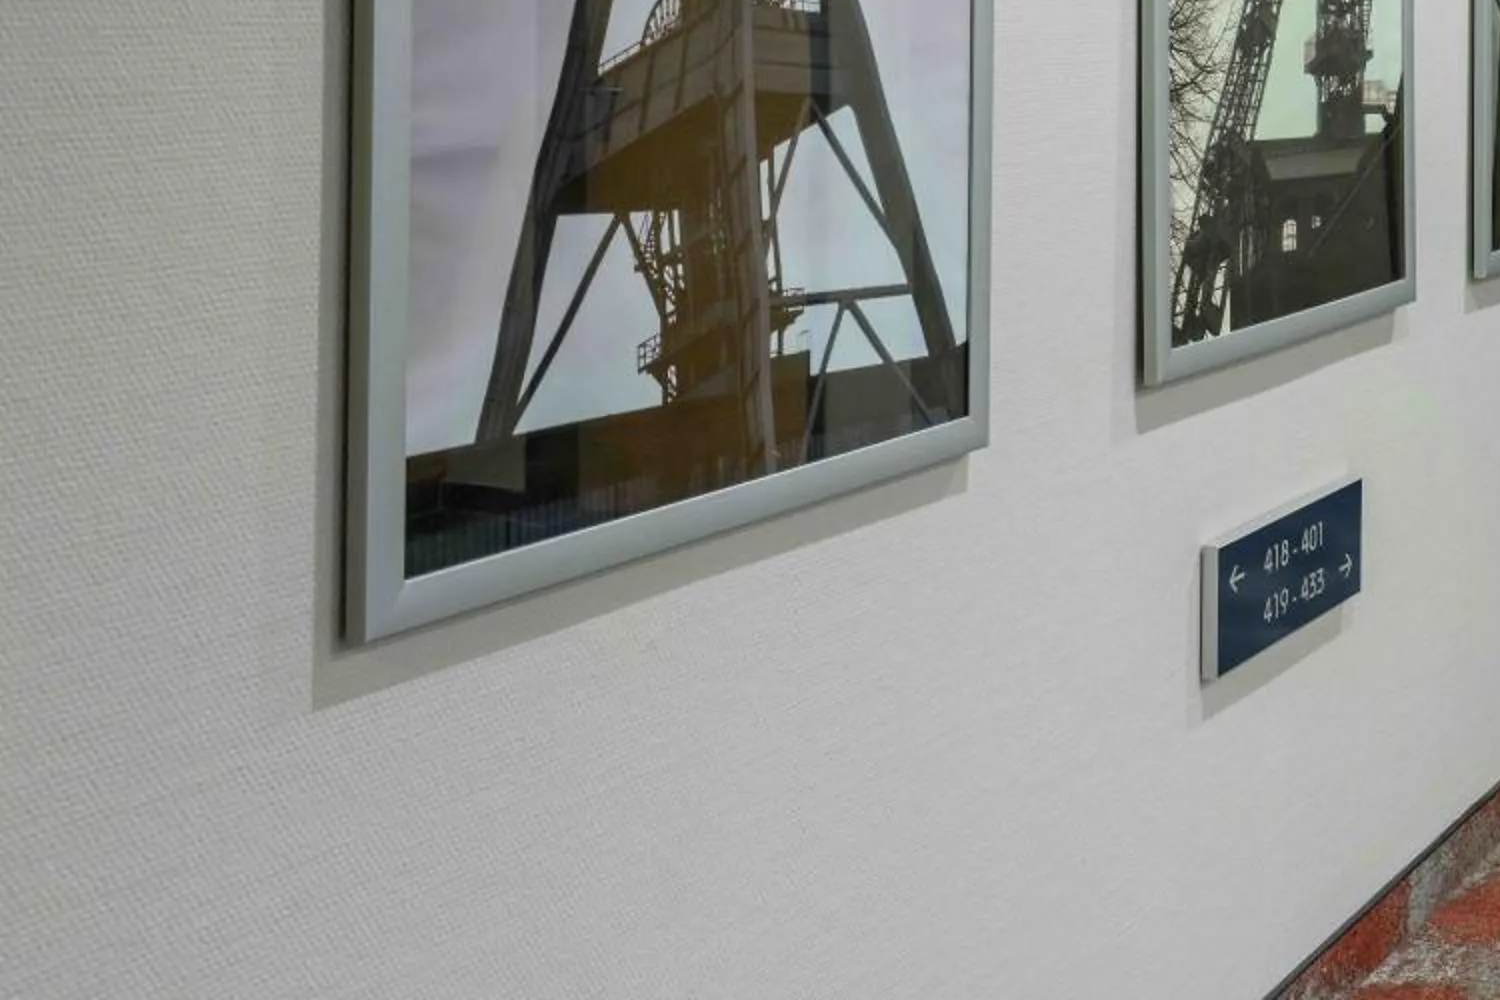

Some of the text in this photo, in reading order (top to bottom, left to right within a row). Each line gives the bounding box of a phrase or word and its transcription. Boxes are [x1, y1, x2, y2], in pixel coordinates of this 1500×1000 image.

[1263, 539, 1289, 572] 418
[1301, 521, 1324, 554] 401
[1263, 588, 1289, 623] 419
[1300, 568, 1325, 601] 433
